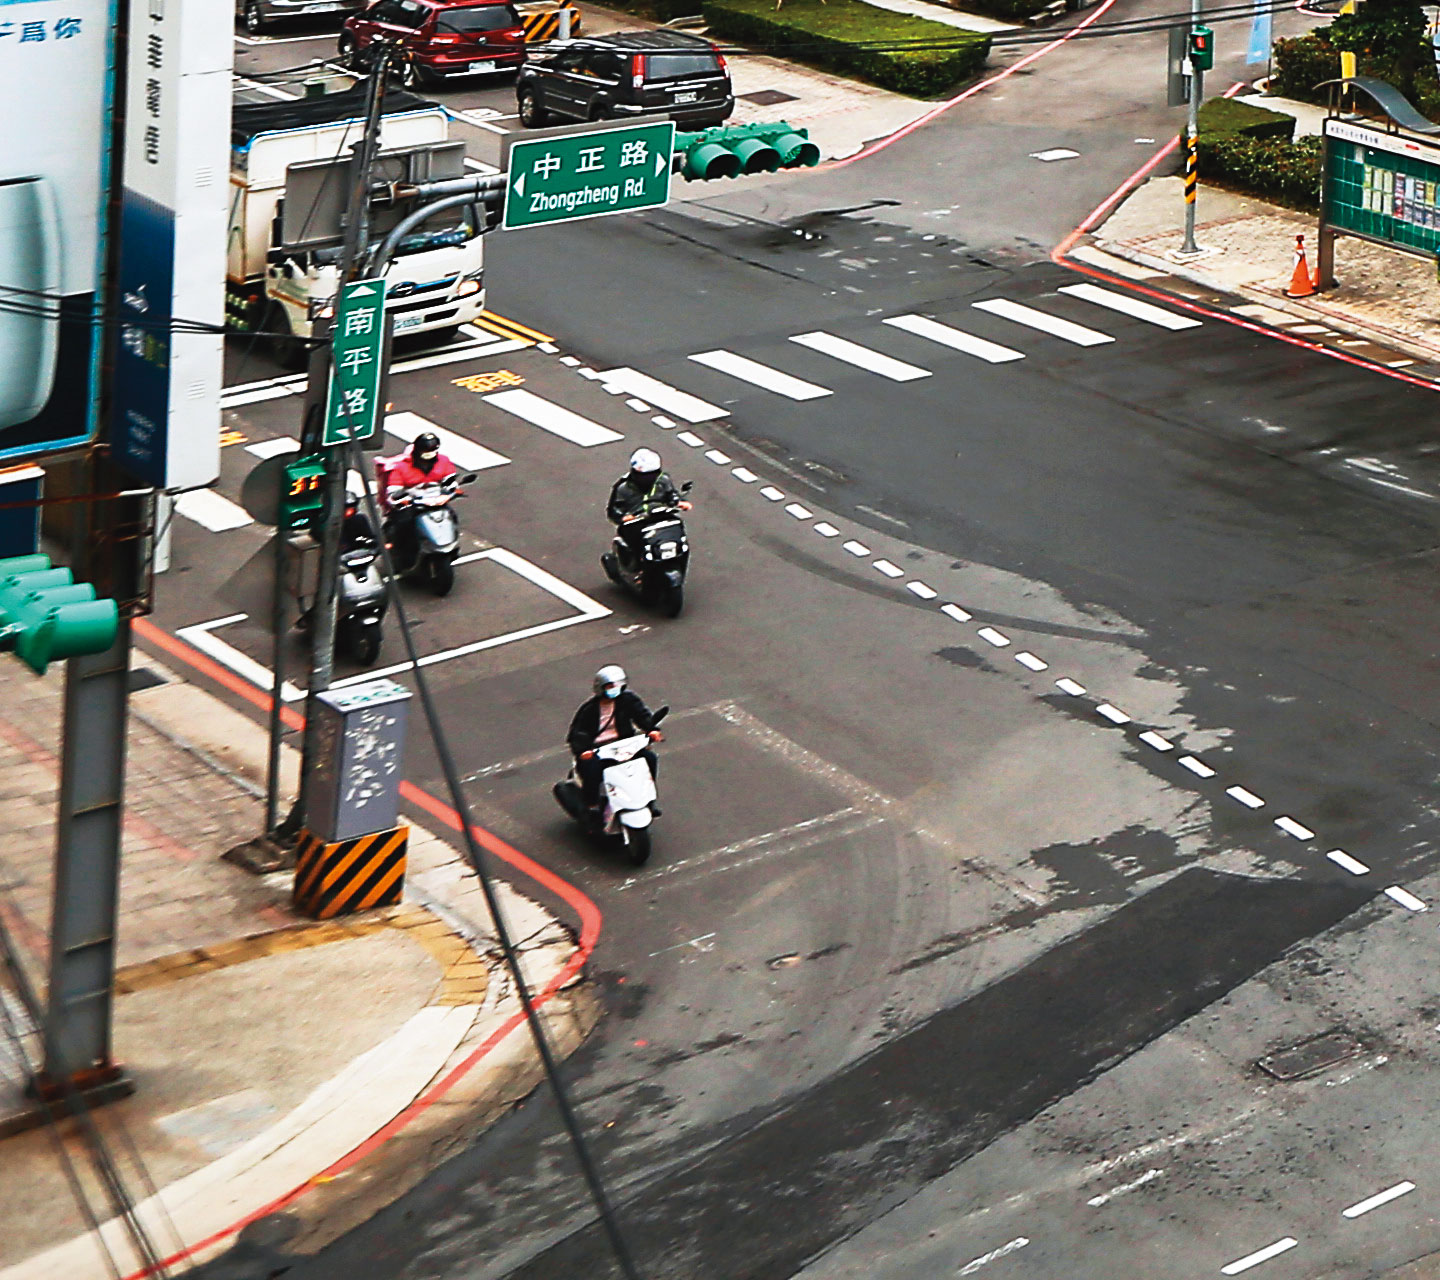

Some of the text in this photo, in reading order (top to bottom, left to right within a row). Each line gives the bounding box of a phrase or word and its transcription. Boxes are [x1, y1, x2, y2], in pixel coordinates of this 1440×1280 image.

[533, 140, 650, 181] 中正路
[529, 176, 647, 214] Zhongzheng Rd.
[335, 307, 377, 418] 南平路
